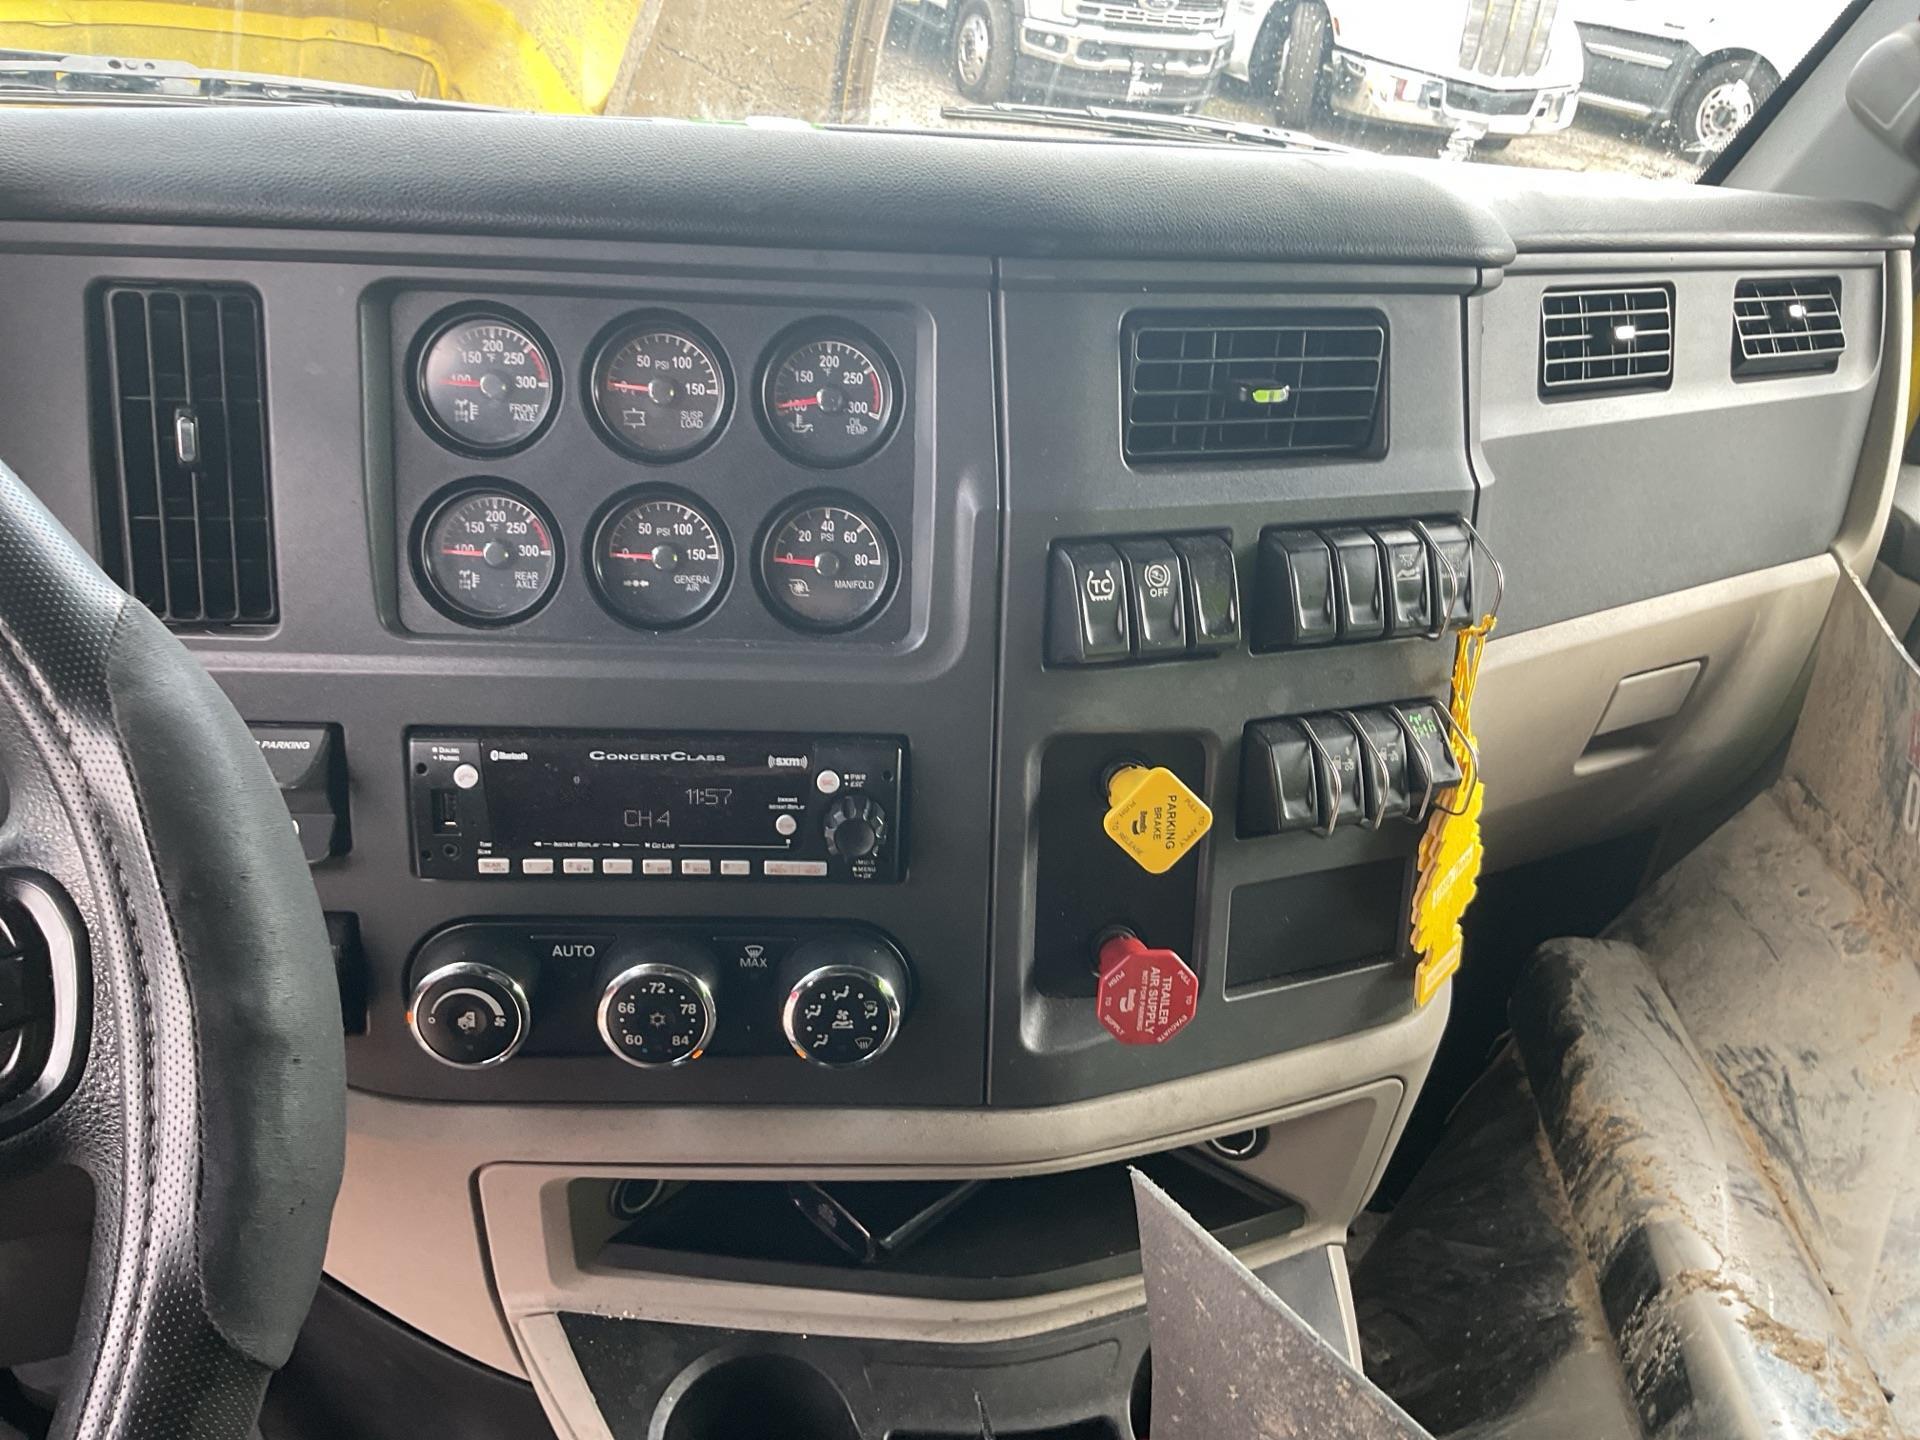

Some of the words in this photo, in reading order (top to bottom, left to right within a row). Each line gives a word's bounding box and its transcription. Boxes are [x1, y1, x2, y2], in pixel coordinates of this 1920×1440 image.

[482, 340, 503, 352] 200
[462, 352, 481, 363] 150
[503, 352, 525, 365] 250
[636, 355, 650, 367] 50
[672, 356, 692, 369] 100
[819, 355, 840, 368] 200
[655, 360, 669, 370] PSI
[515, 376, 537, 389] 300
[794, 370, 814, 383] 150
[843, 372, 863, 385] 250
[685, 383, 705, 396] 150
[509, 403, 539, 413] FRONT
[848, 402, 868, 414] 300
[513, 413, 535, 422] AXLE
[680, 410, 704, 420] SUSP
[680, 419, 703, 429] LOAD
[845, 425, 868, 435] TEMP
[486, 510, 506, 523] 200
[465, 521, 485, 533] 150
[506, 522, 527, 534] 250
[638, 522, 652, 535] 50
[656, 527, 671, 536] PSI
[673, 523, 693, 536] 100
[821, 520, 834, 532] 40
[798, 530, 812, 542] 20
[821, 533, 834, 542] PSI
[843, 531, 857, 543] 60
[518, 545, 539, 557] 300
[687, 549, 706, 561] 150
[854, 554, 868, 566] 80
[514, 571, 539, 580] REAR
[674, 575, 711, 585] GENERAL
[515, 580, 538, 589] AXLE
[685, 584, 701, 592] AIR
[834, 580, 875, 590] MANIFOLD
[1091, 579, 1111, 593] TC
[1150, 588, 1169, 598] OFF
[261, 740, 310, 750] PARKING
[685, 788, 732, 805] 11:57
[624, 809, 652, 828] CH
[656, 810, 670, 828] 4
[1153, 807, 1162, 841] BRAKE
[1165, 794, 1177, 850] PARKING
[552, 945, 596, 958] AUTO
[739, 957, 768, 968] MAX
[1107, 970, 1125, 988] PUSH
[1150, 966, 1161, 987] AIR
[649, 982, 666, 994] 72
[1158, 976, 1172, 1025] TRAILER
[1185, 995, 1193, 1005] TO
[617, 1002, 635, 1014] 66
[680, 1003, 697, 1015] 78
[1144, 989, 1159, 1035] SUPPLY
[1156, 1014, 1188, 1043] EVACUATE
[625, 1034, 643, 1046] 60
[672, 1035, 689, 1046] 84
